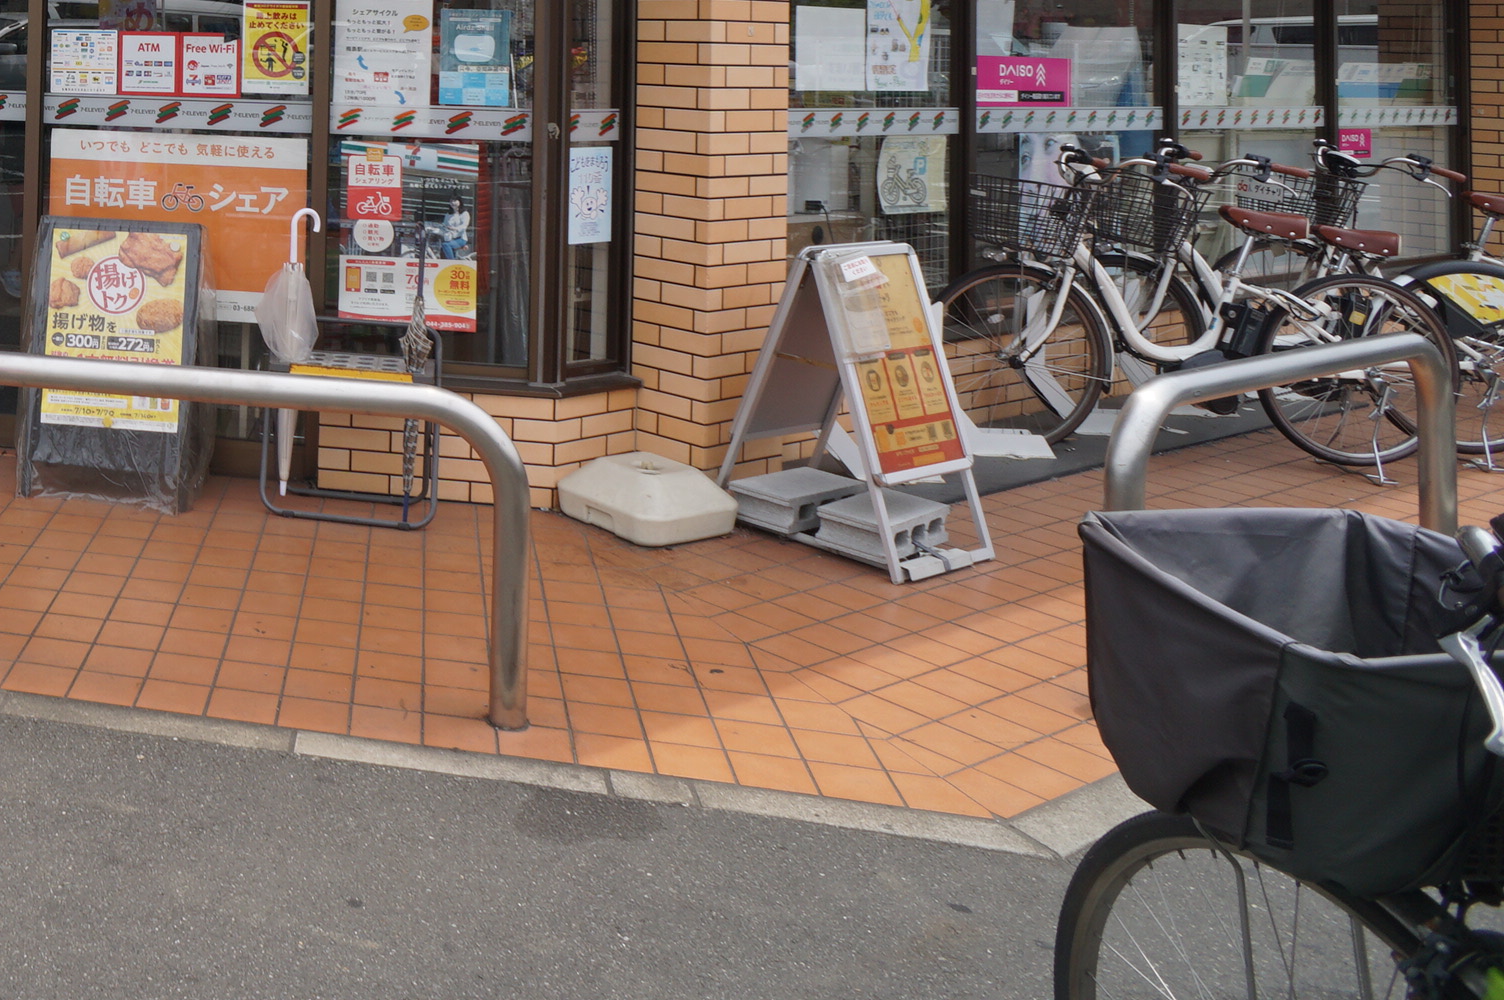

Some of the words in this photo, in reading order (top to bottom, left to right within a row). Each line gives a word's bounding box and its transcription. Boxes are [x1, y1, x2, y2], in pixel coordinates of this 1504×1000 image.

[352, 8, 399, 16] シェアサイクル
[249, 21, 305, 29] 止めてください
[137, 43, 160, 52] ATM
[186, 44, 207, 53] Free
[209, 44, 235, 53] Wi-Fi
[999, 64, 1033, 77] DAISO
[80, 139, 130, 152] いつでも
[139, 142, 188, 155] どこでも
[196, 143, 275, 159] 気軽に使える
[355, 163, 395, 176] 自転車
[65, 174, 158, 210] 自転車
[208, 183, 289, 214] シェア
[449, 280, 470, 290] 無料
[52, 311, 117, 333] 揚げ物を
